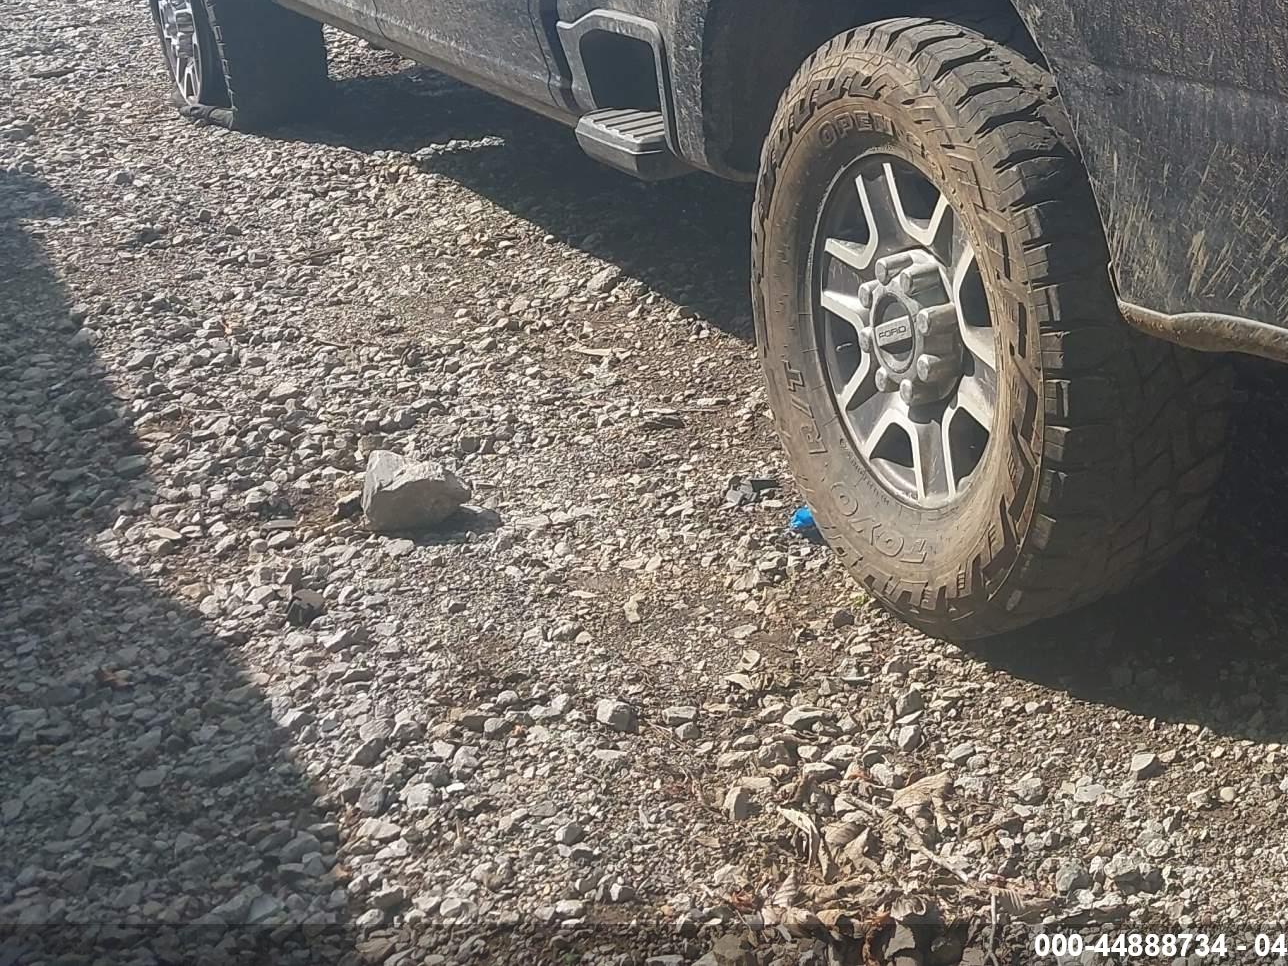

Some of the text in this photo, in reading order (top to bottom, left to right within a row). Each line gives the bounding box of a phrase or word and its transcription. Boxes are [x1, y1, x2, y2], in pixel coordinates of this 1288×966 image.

[818, 110, 895, 148] OPEN
[879, 325, 906, 338] FORD
[831, 481, 928, 564] TOYO
